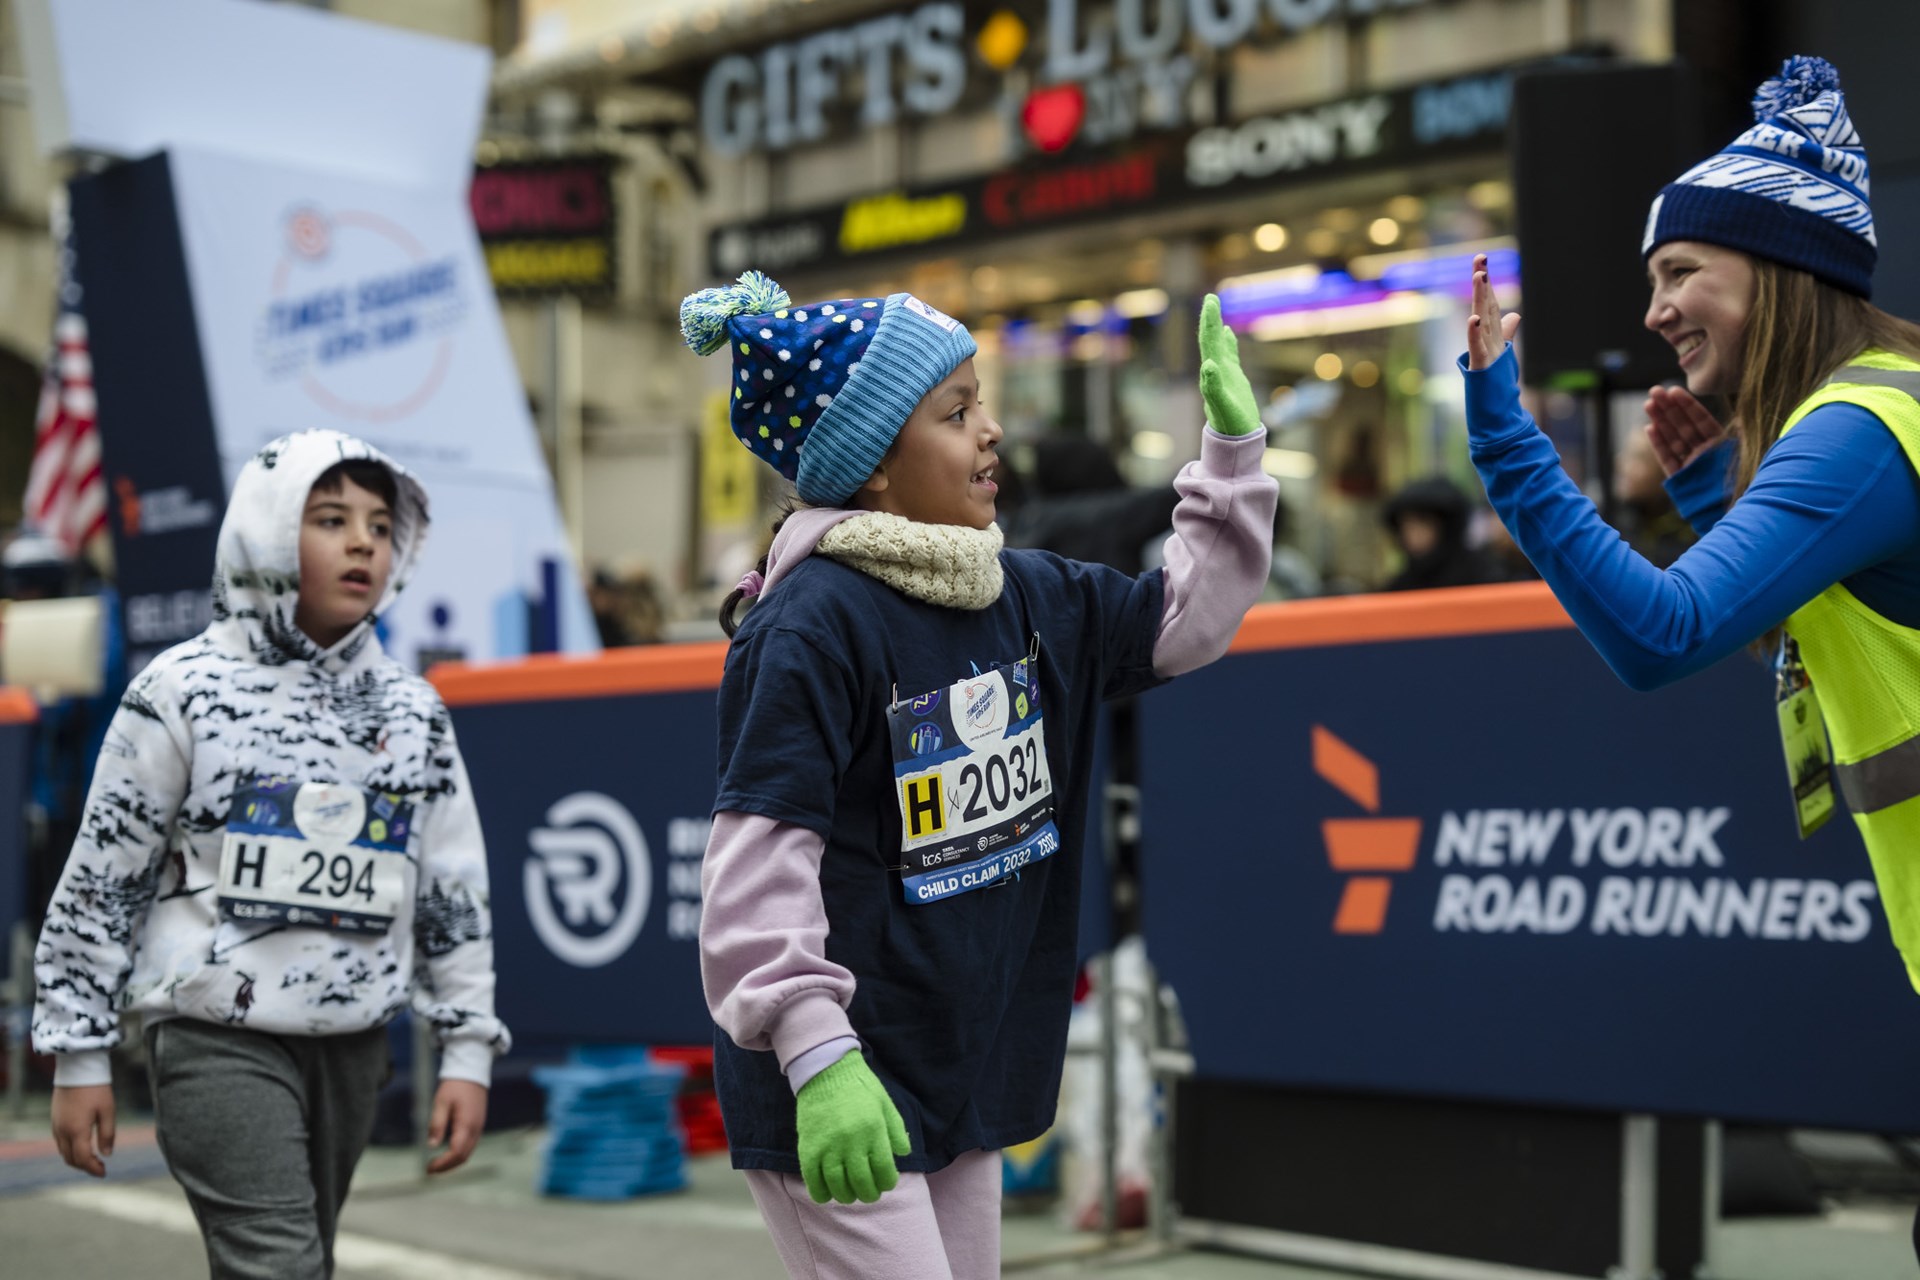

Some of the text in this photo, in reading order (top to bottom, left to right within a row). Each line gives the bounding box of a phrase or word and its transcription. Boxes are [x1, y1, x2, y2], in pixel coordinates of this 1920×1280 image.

[700, 2, 966, 159] GIFTS
[1186, 96, 1391, 186] SONY
[841, 191, 966, 254] Nikon
[982, 152, 1155, 227] Canon
[908, 777, 942, 836] H
[959, 737, 1042, 823] 2032
[922, 852, 942, 867] tcs
[1432, 806, 1731, 867] NEW YORK
[232, 843, 376, 903] H 294
[918, 877, 959, 899] CHILD
[961, 862, 1000, 887] CLAIM
[1003, 848, 1031, 873] 2032
[1432, 874, 1878, 943] ROAD RUNNERS
